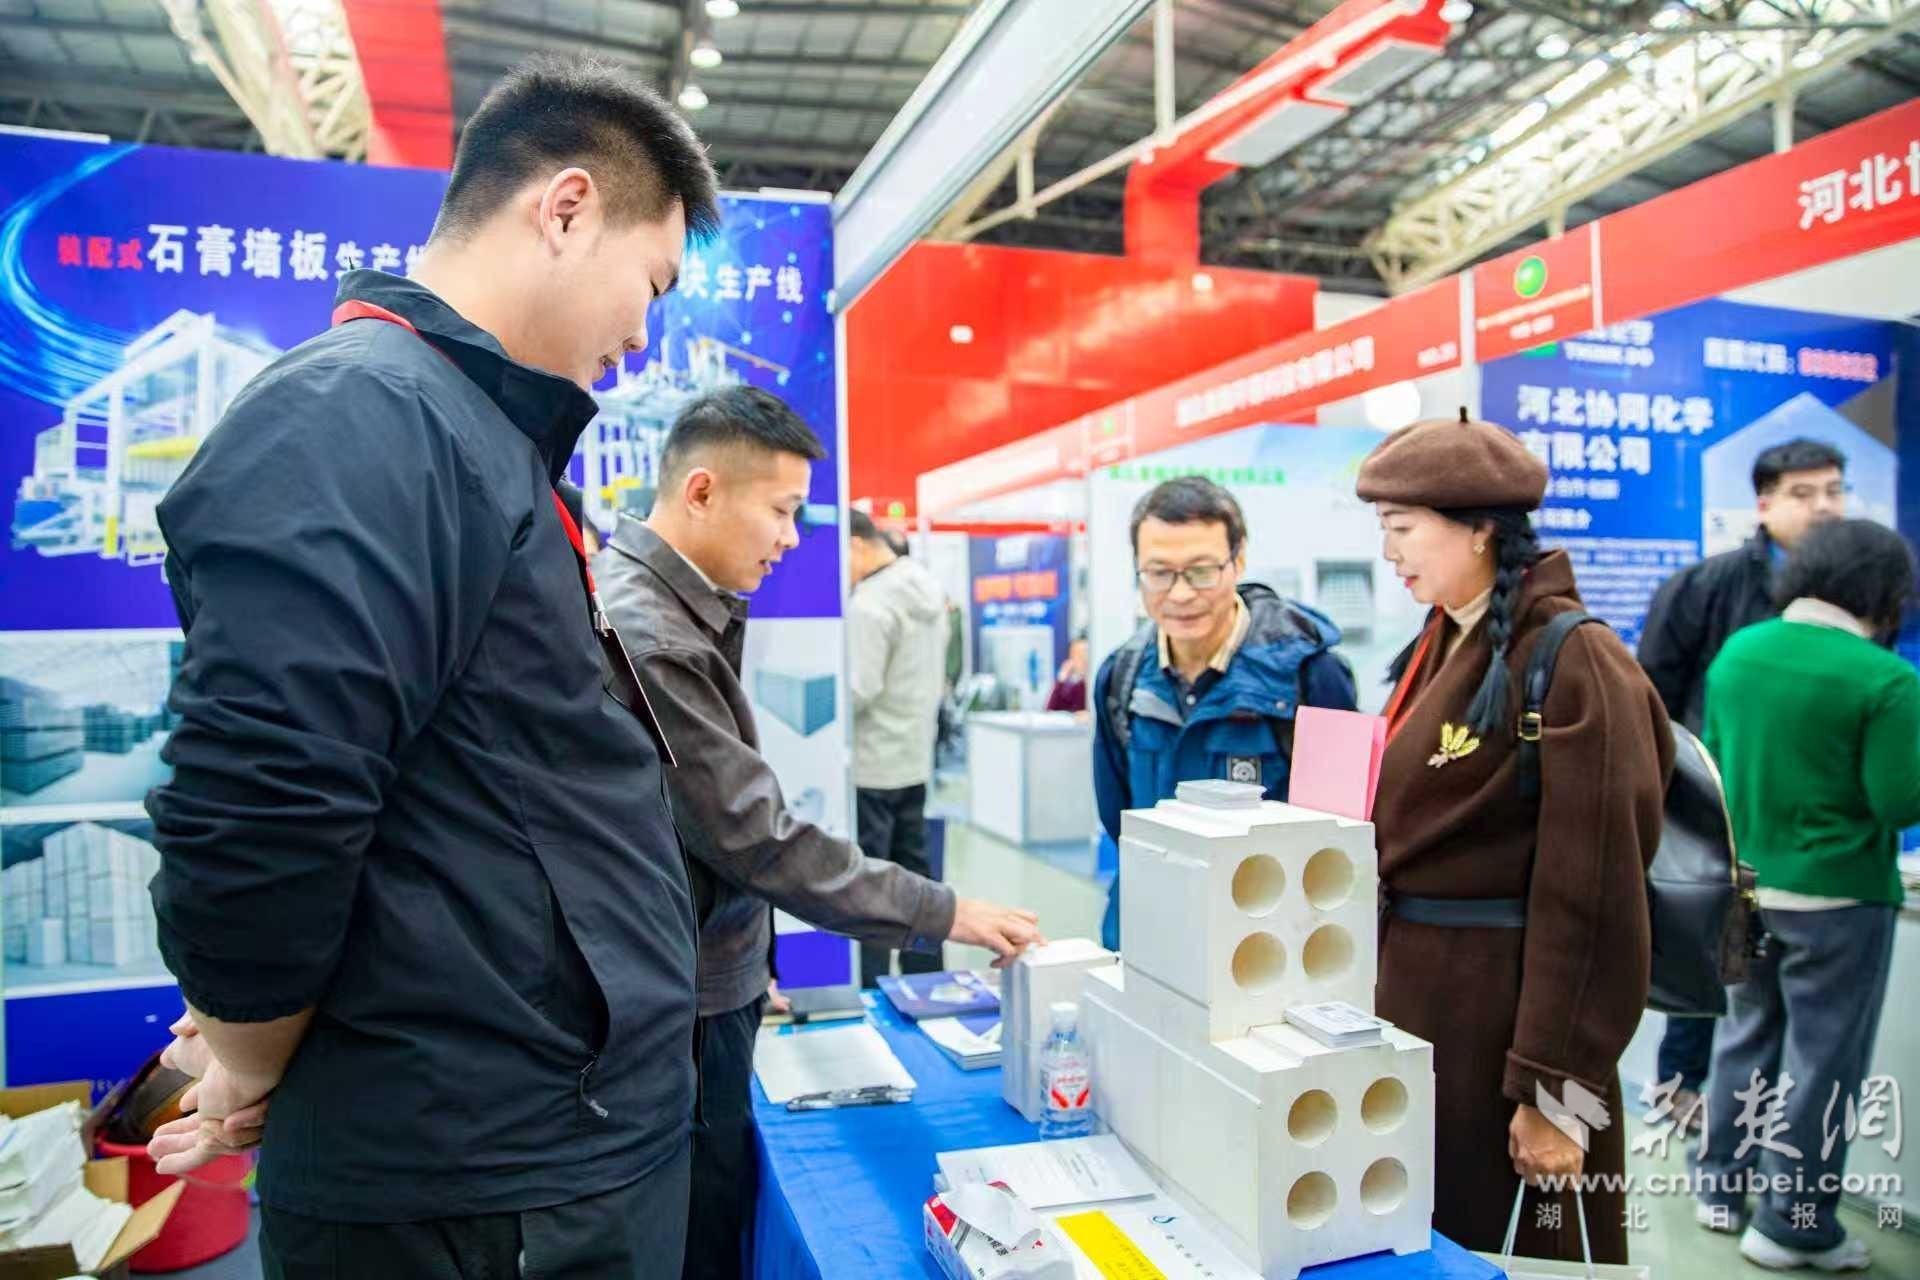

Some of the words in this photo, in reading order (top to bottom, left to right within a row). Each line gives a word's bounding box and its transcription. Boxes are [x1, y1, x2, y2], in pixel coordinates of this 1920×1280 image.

[1517, 384, 1714, 436] 河北协同化学
